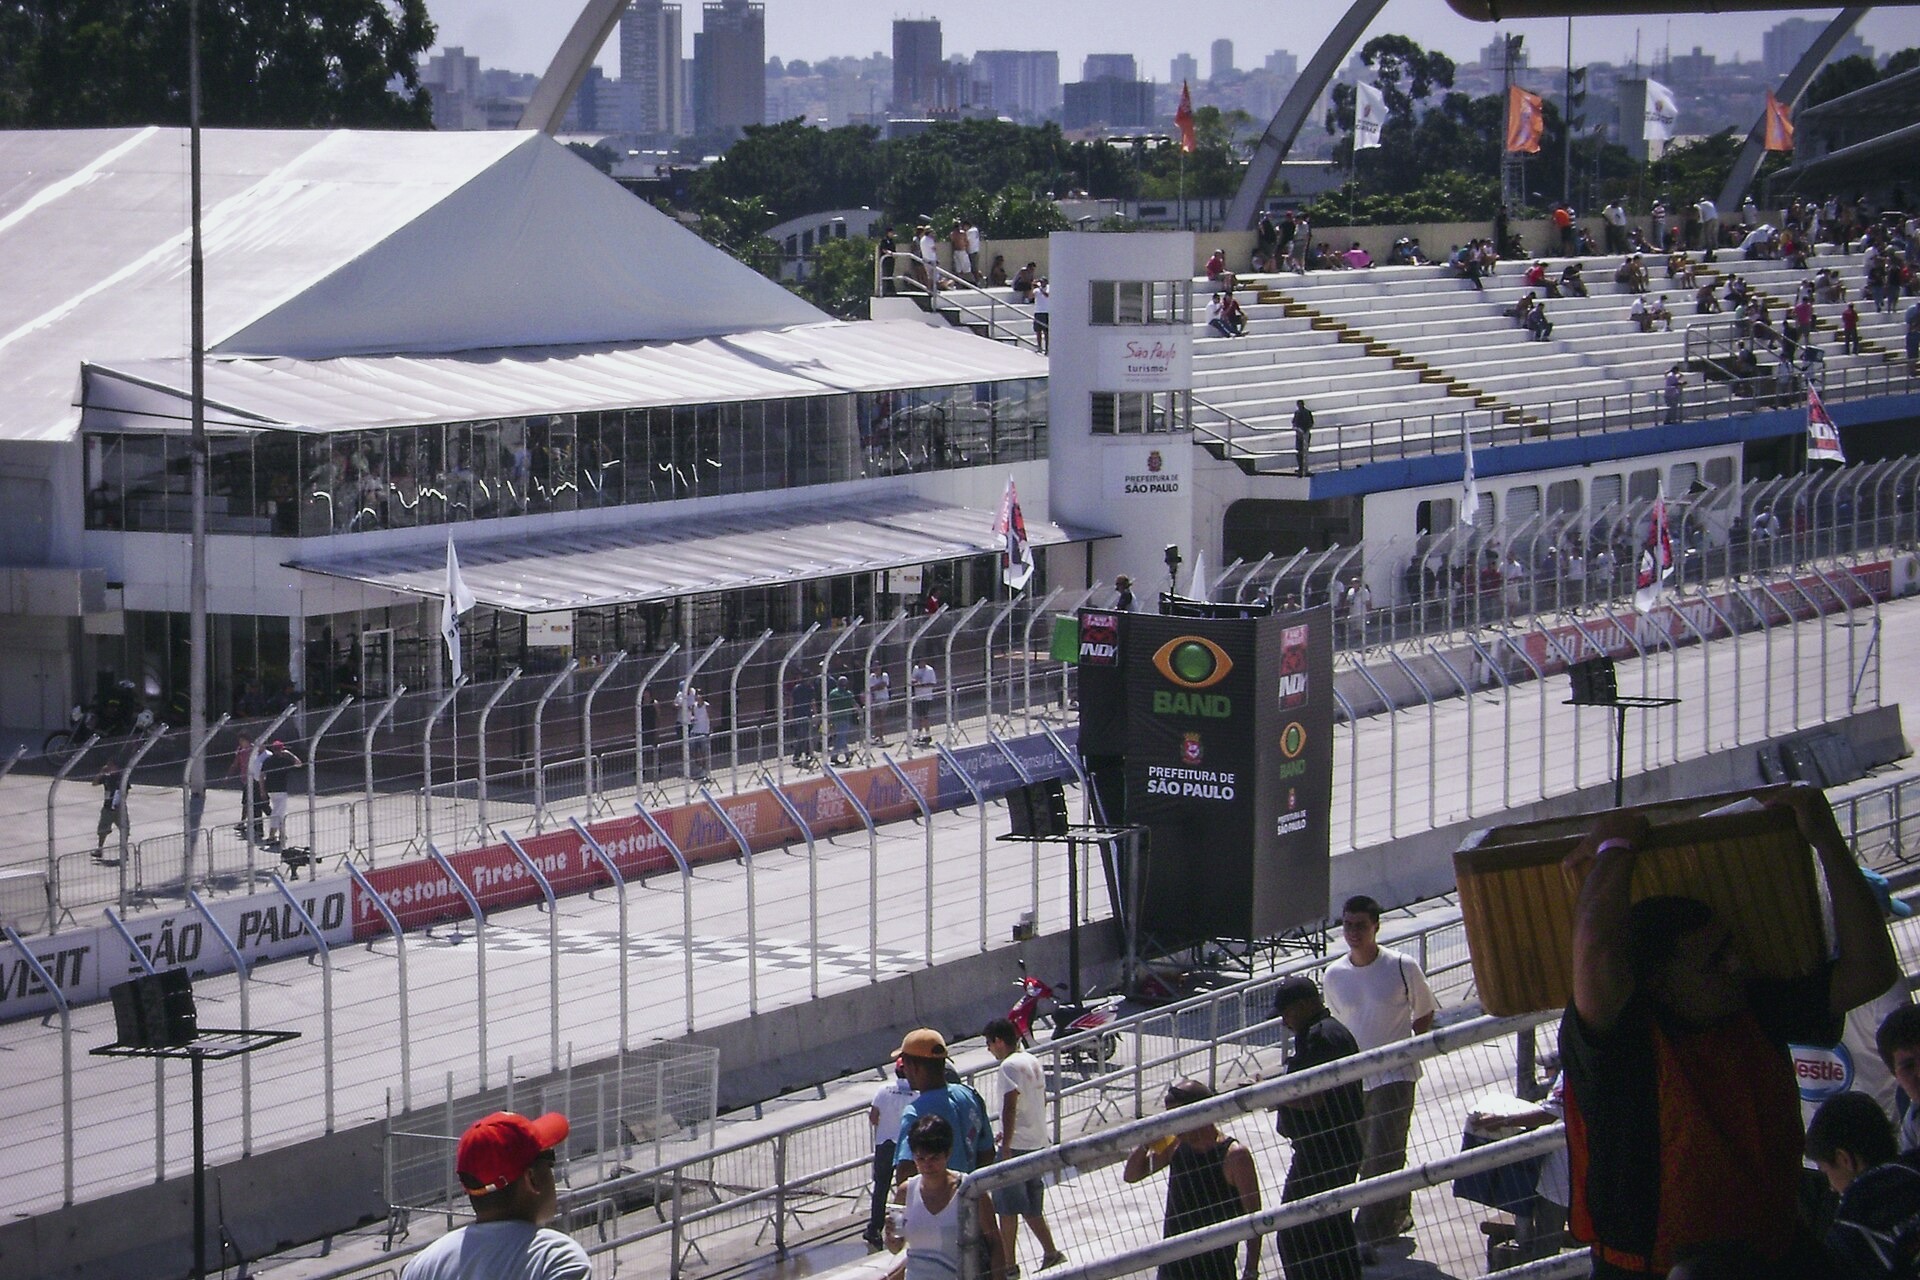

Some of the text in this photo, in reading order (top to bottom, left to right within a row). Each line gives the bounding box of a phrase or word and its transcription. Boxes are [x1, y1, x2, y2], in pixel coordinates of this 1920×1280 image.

[1125, 474, 1179, 483] PREFEITURA DE
[1149, 483, 1179, 493] PAULO
[1153, 690, 1232, 718] BAND
[1148, 766, 1235, 784] PREFEITURA DE
[1147, 777, 1235, 801] SÃO PAULO
[237, 892, 345, 950] PAULO
